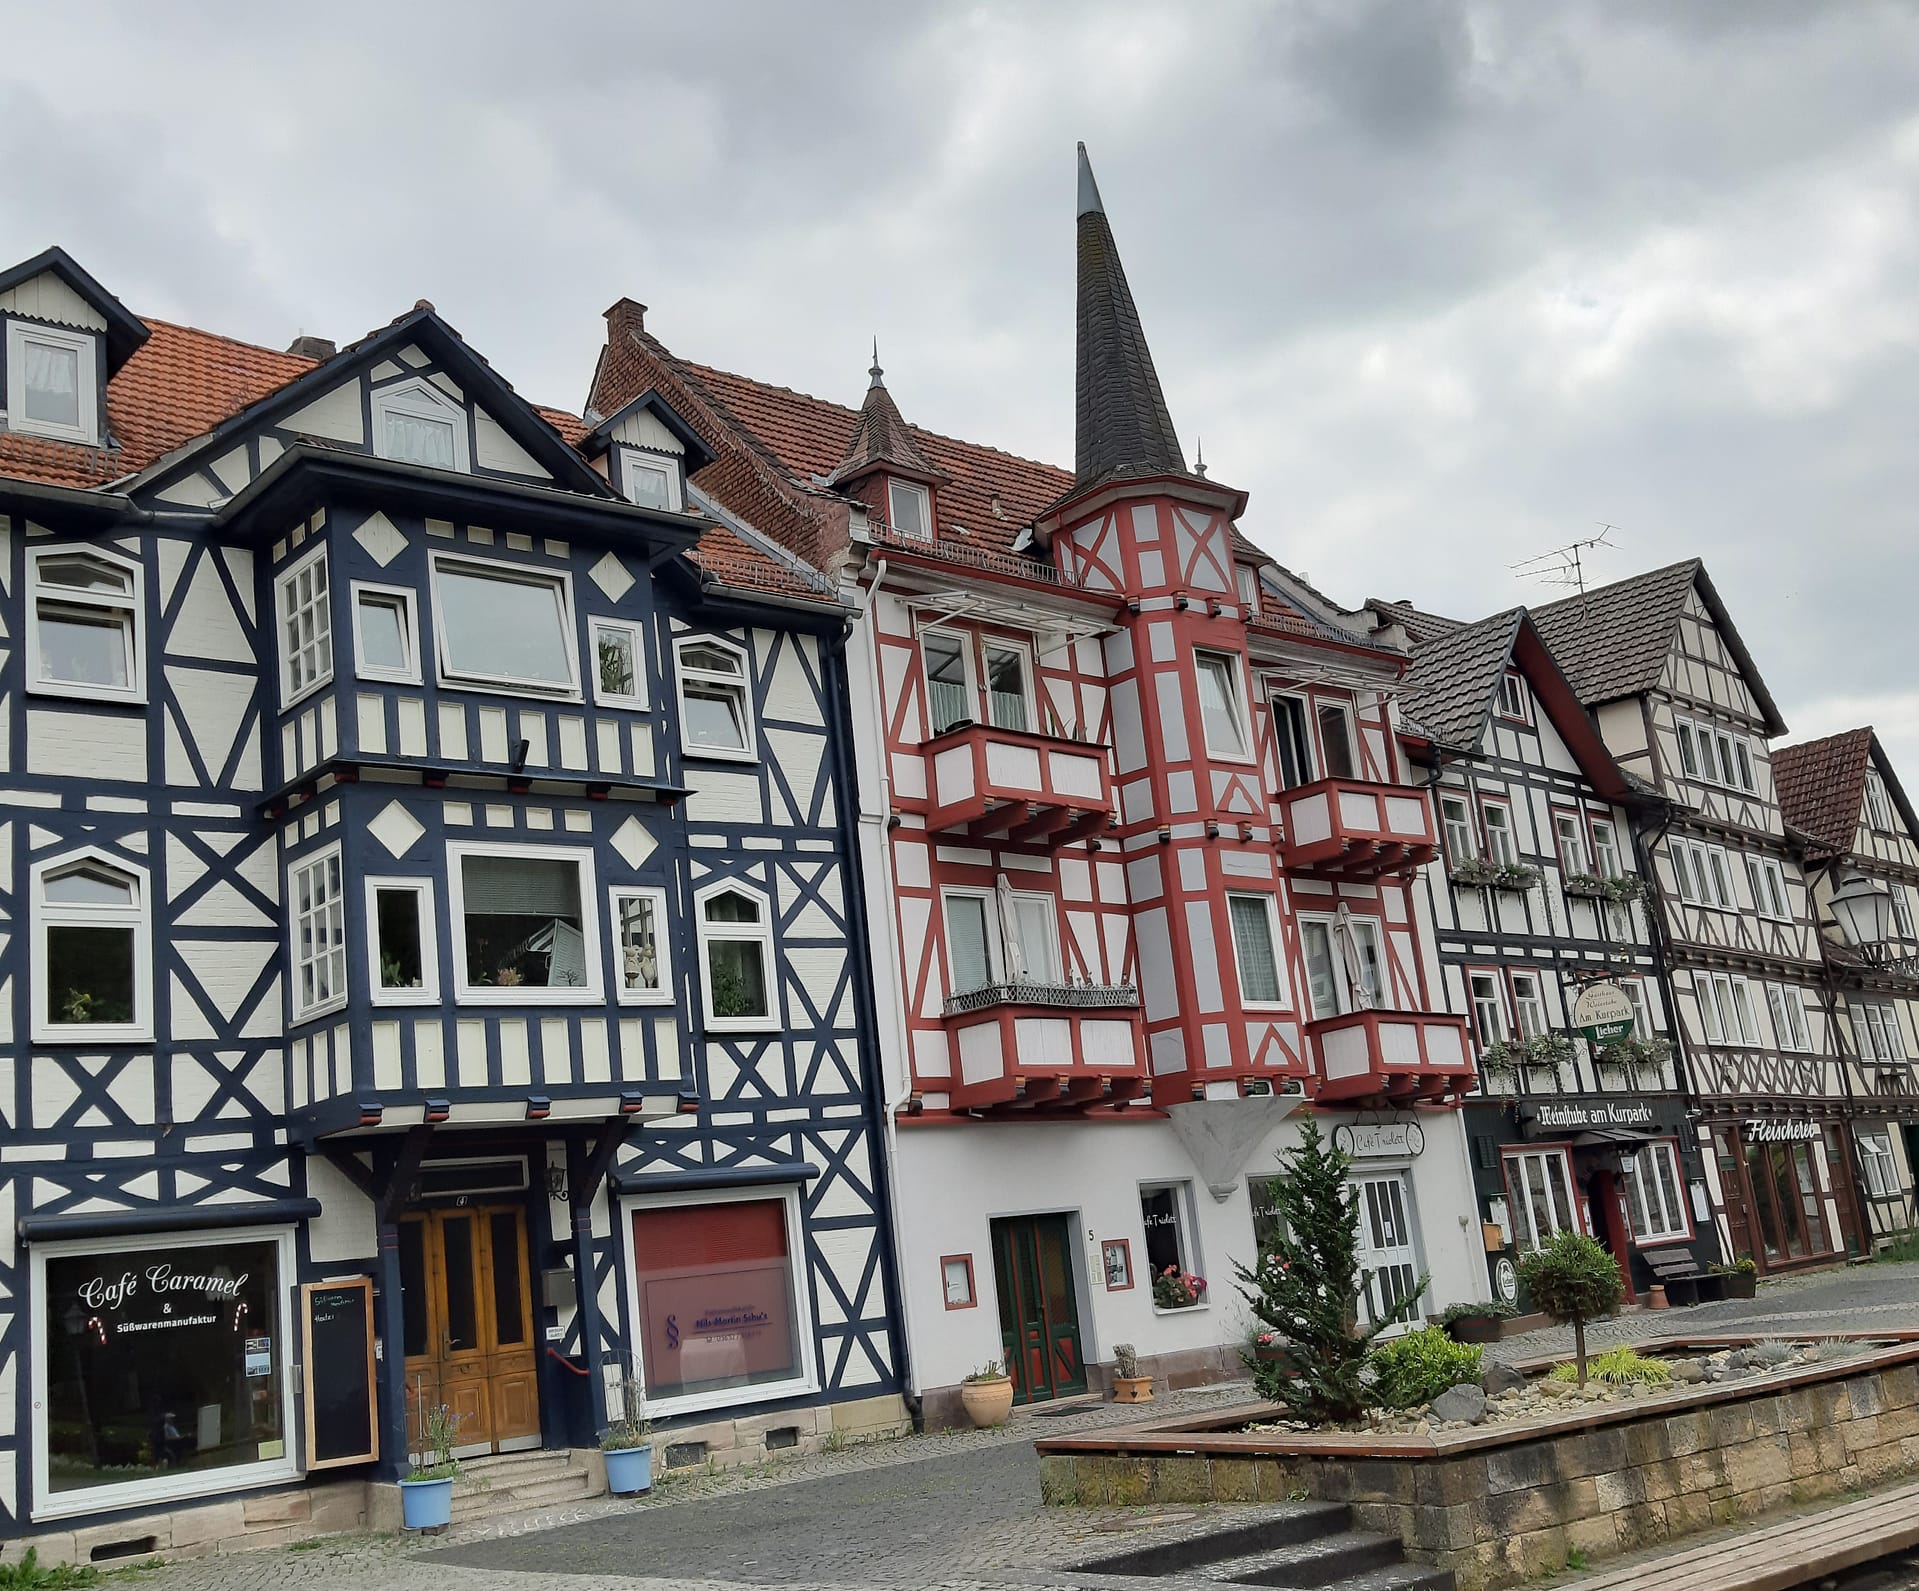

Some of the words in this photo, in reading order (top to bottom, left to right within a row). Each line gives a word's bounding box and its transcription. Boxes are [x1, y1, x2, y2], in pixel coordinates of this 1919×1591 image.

[1580, 1013, 1592, 1022] Am
[1595, 1005, 1630, 1020] Kurpark
[1595, 1024, 1624, 1039] Licher
[1590, 1108, 1605, 1124] am
[1606, 1102, 1650, 1125] Kurpark
[1745, 1118, 1815, 1141] Fleischerei
[1088, 1229, 1095, 1241] 5
[78, 1271, 137, 1310] Café
[145, 1263, 249, 1297] Caramel
[163, 1303, 172, 1314] &
[116, 1314, 217, 1333] Süßwarenmanufaktur
